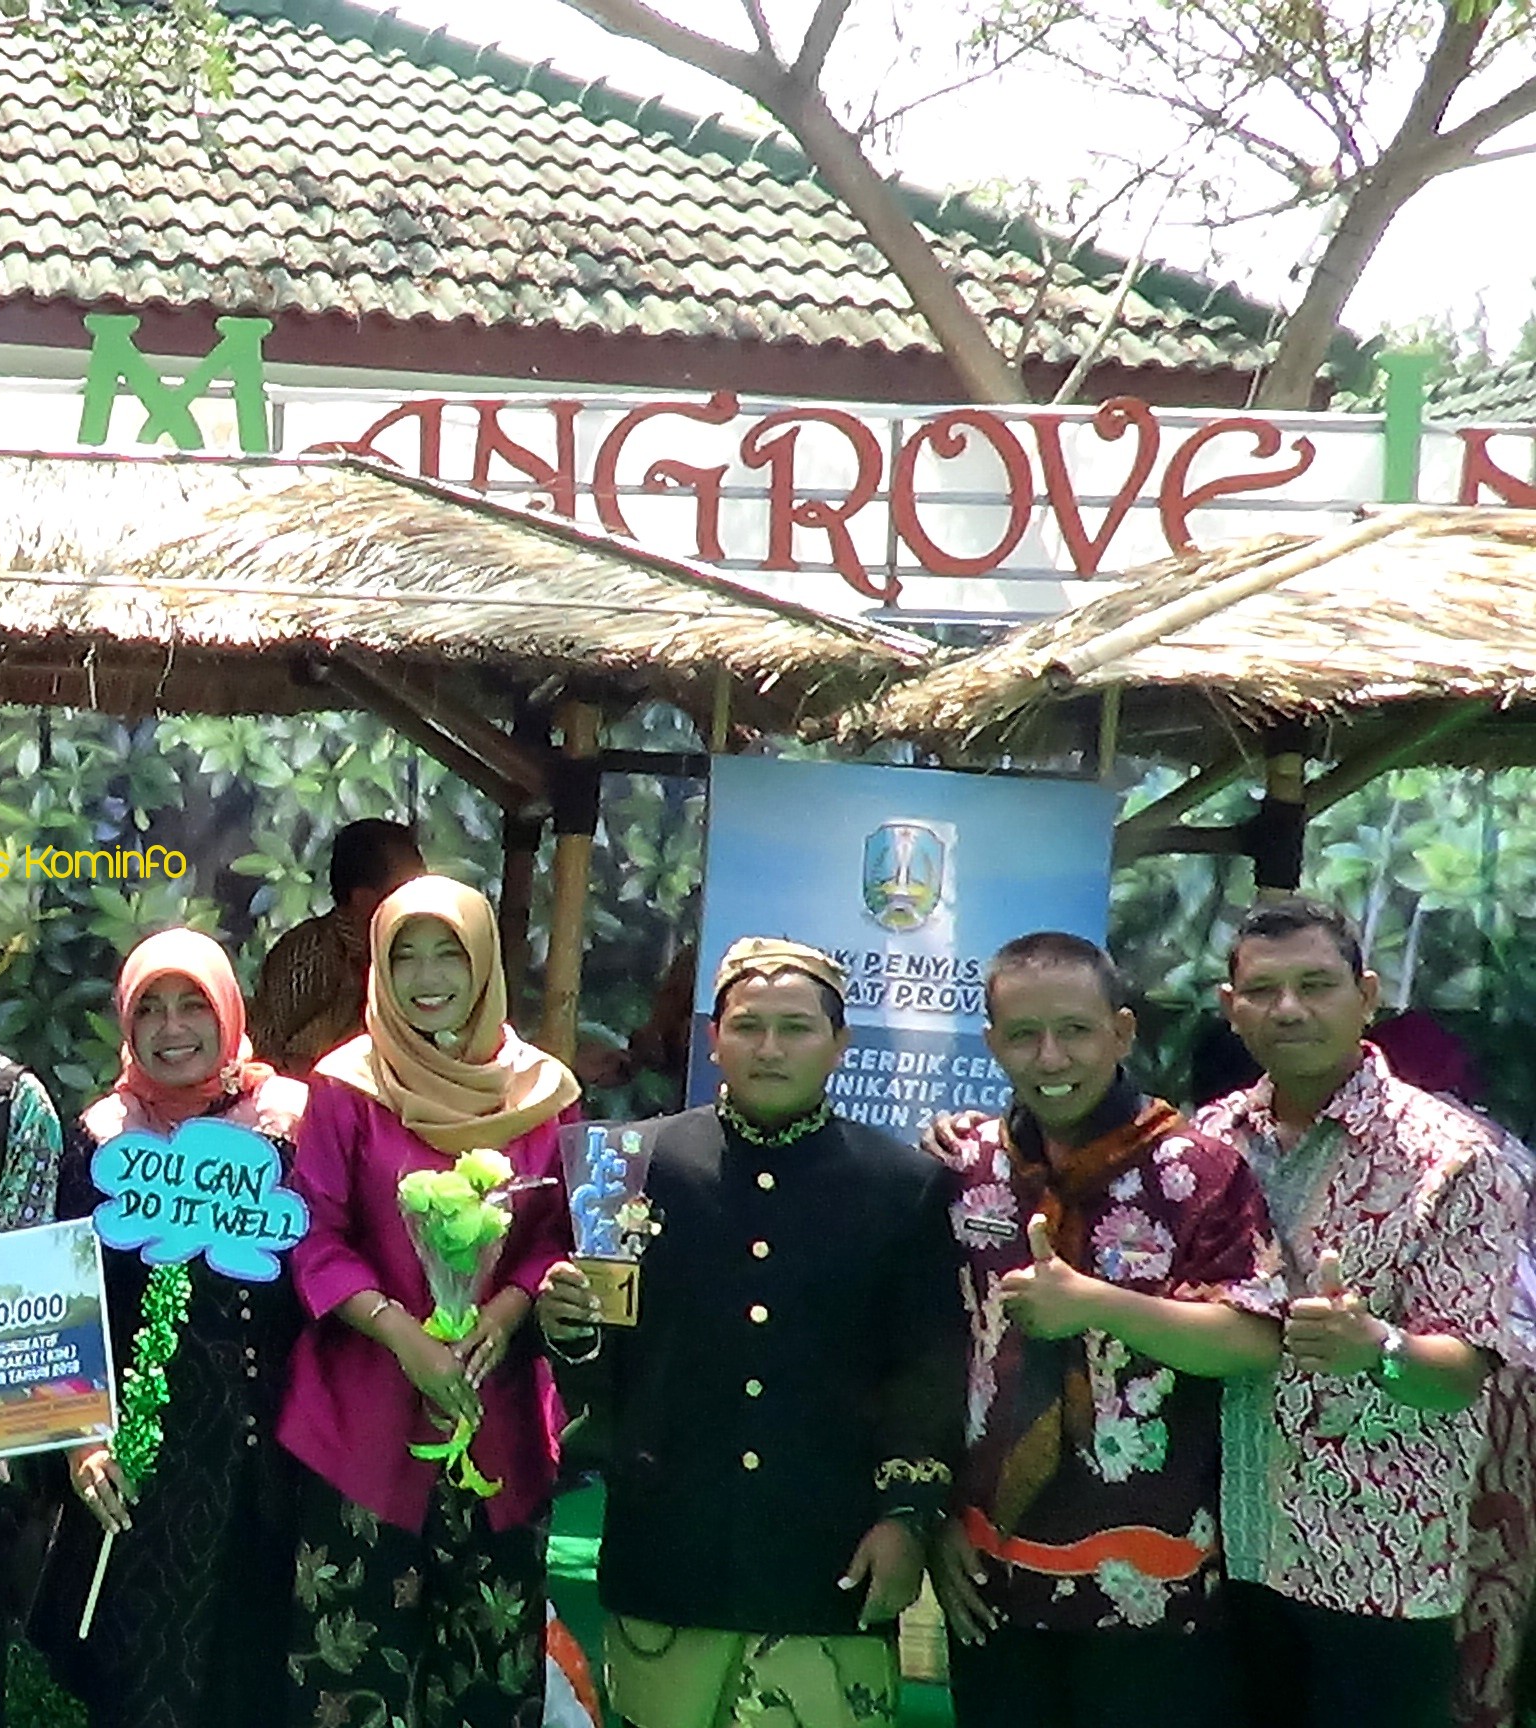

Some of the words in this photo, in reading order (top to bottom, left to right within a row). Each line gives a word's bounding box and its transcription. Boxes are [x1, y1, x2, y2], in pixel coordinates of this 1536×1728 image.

[843, 1047, 946, 1076] CERDIK
[117, 1147, 186, 1187] YOU
[194, 1156, 272, 1204] CAN
[118, 1188, 162, 1220] DO
[169, 1196, 213, 1227] IT
[212, 1201, 301, 1241] WELL
[617, 1271, 635, 1318] 1
